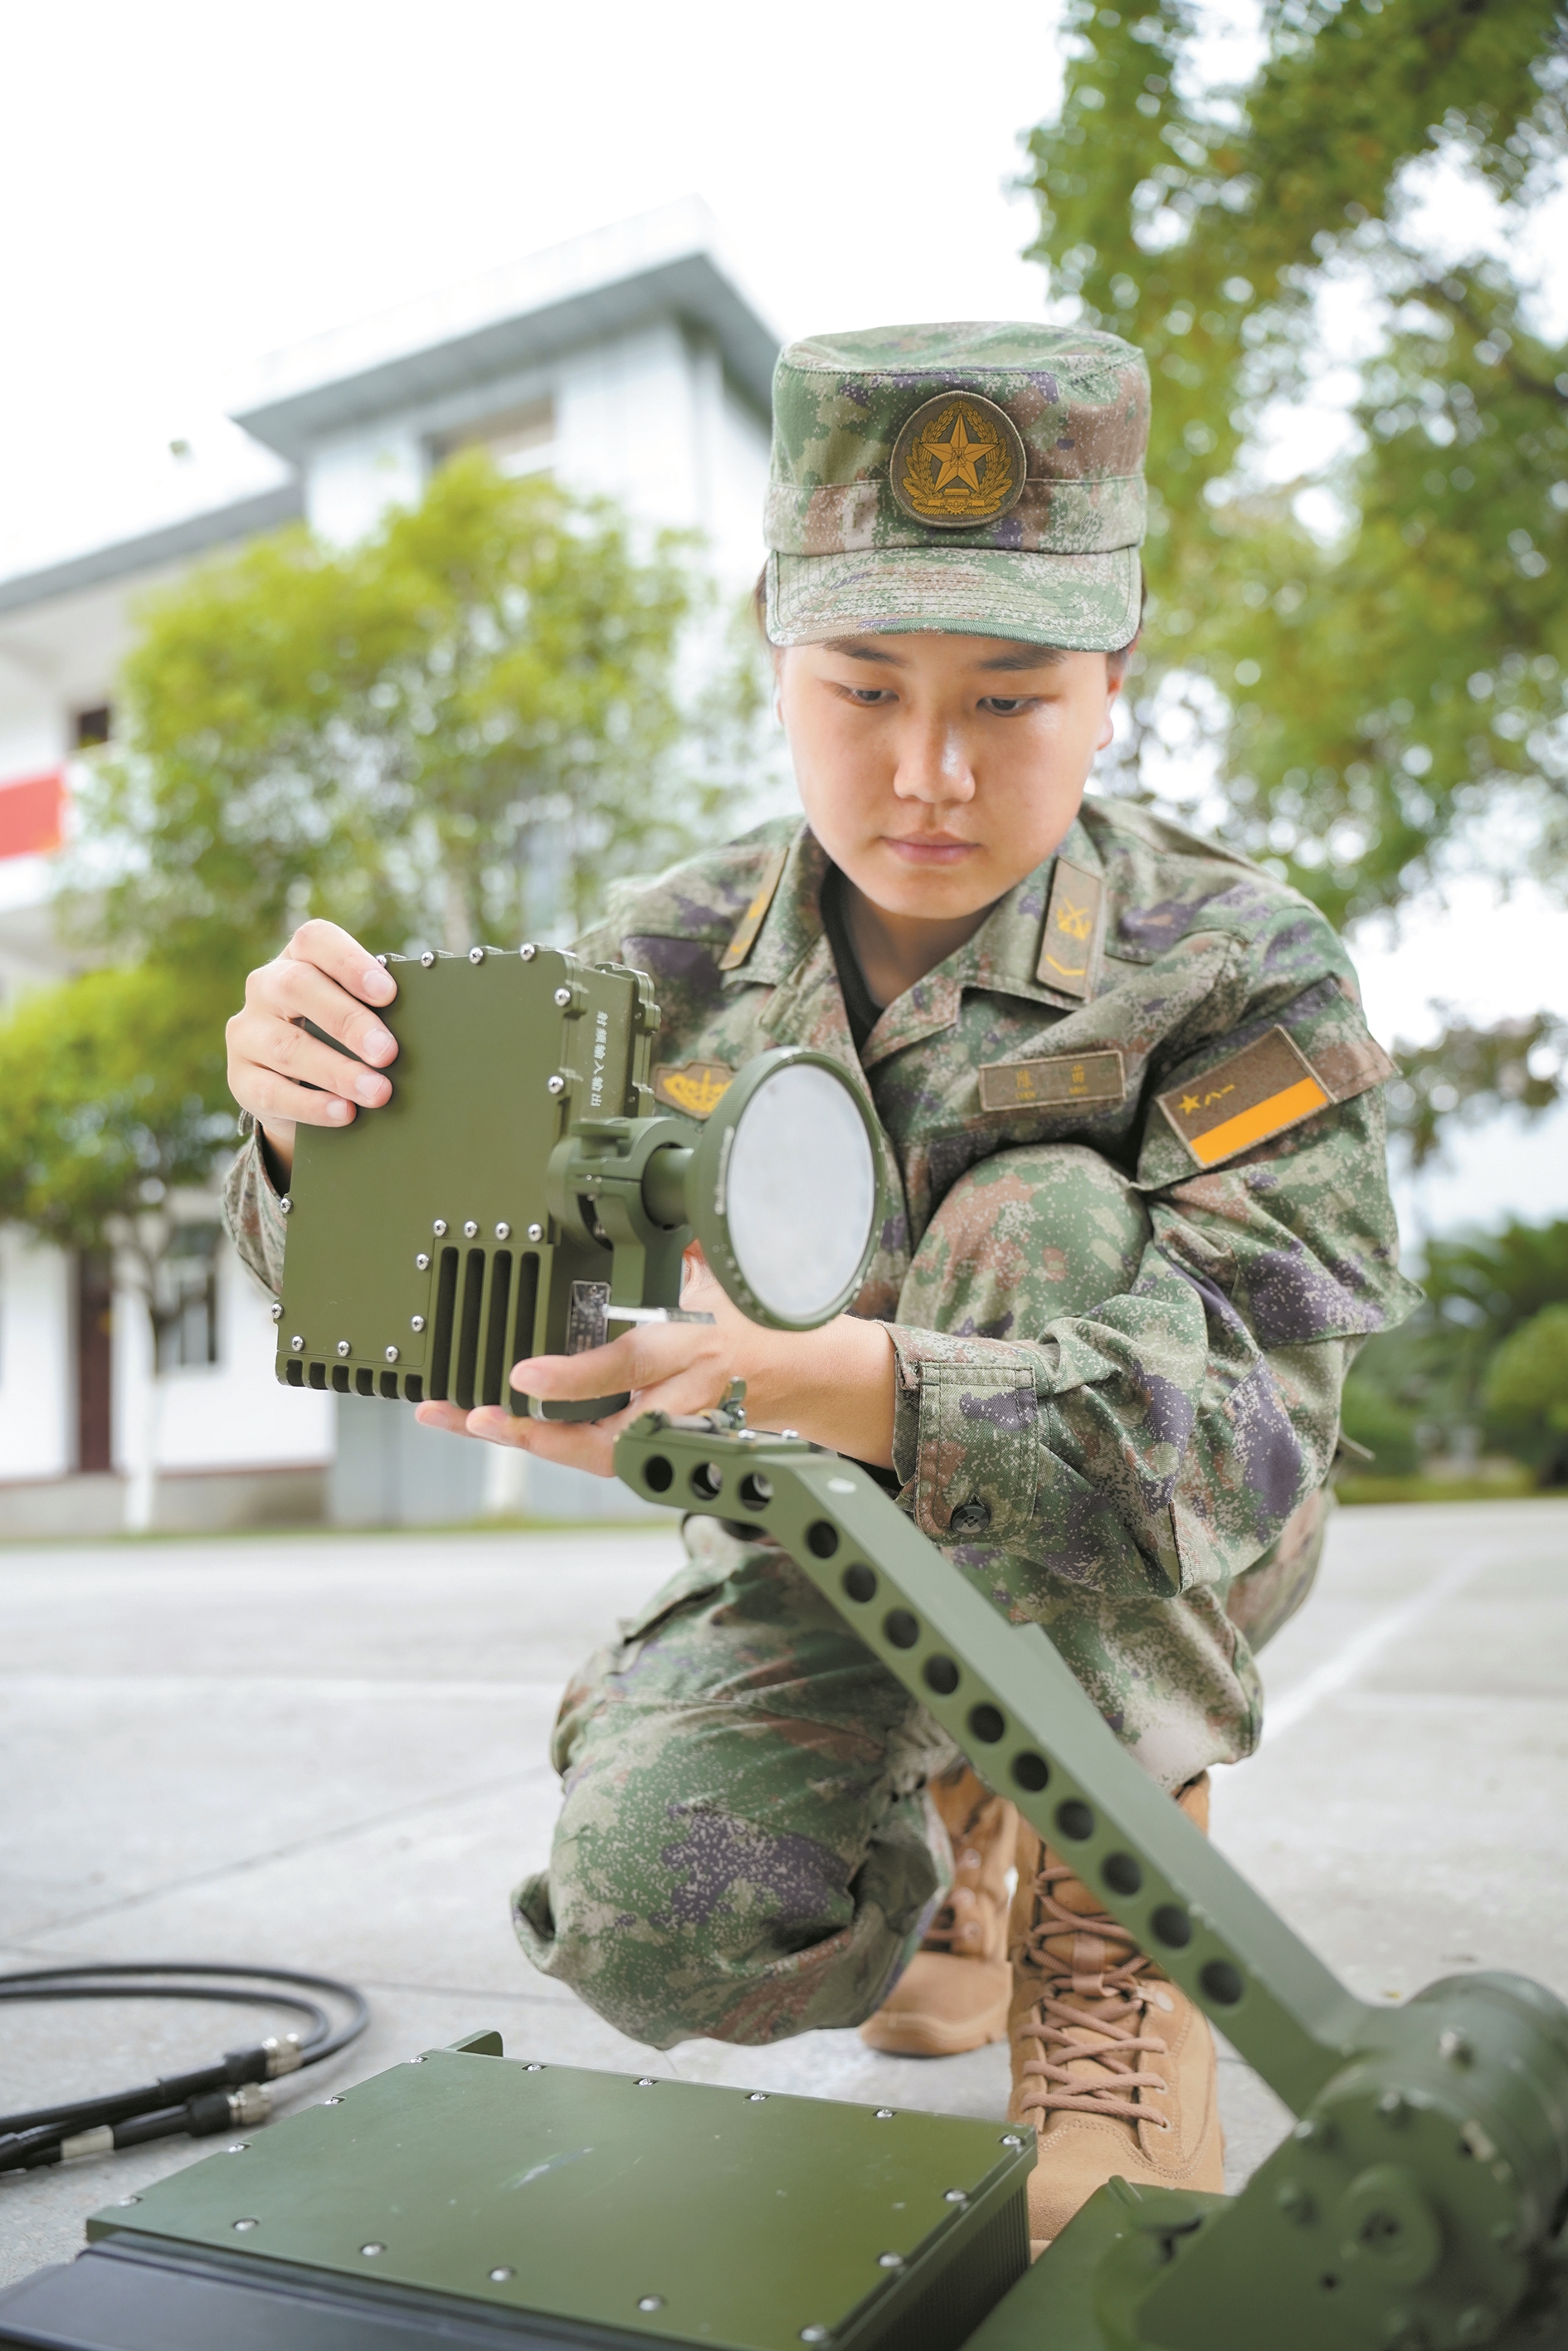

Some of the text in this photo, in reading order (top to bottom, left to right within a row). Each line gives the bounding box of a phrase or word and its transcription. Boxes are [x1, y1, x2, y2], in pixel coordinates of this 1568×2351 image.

[590, 1010, 609, 1107] 射频输入输出
